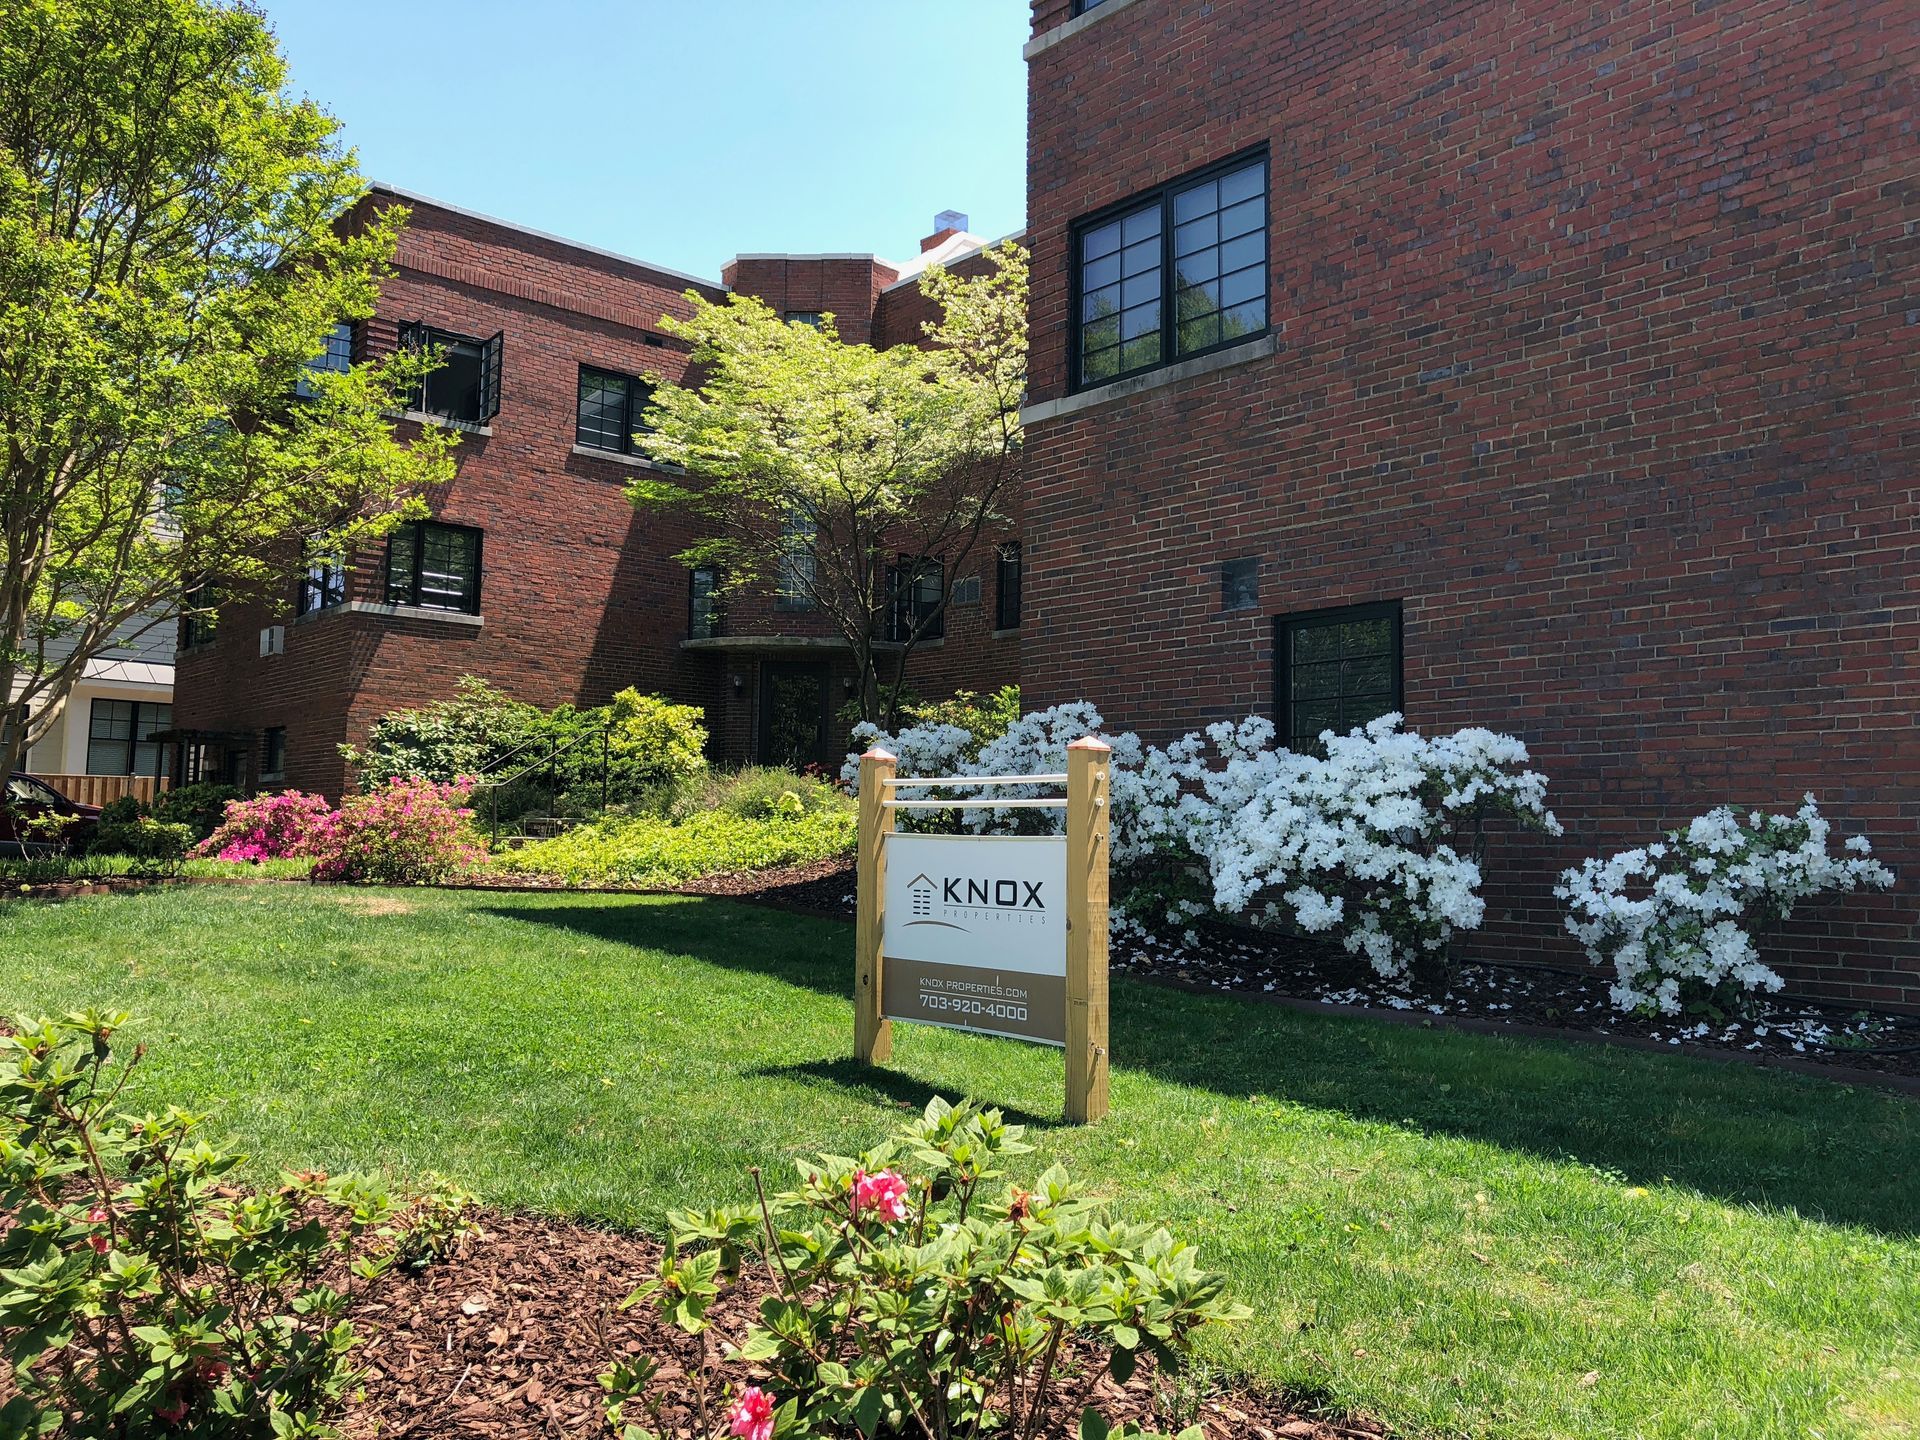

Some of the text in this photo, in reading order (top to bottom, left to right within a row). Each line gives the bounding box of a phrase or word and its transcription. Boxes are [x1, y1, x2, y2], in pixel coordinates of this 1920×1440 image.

[943, 877, 1045, 909] KNOX
[943, 909, 1046, 925] PROPERTIES
[919, 977, 944, 988] KNOX
[919, 994, 1028, 1021] 703-920-4000
